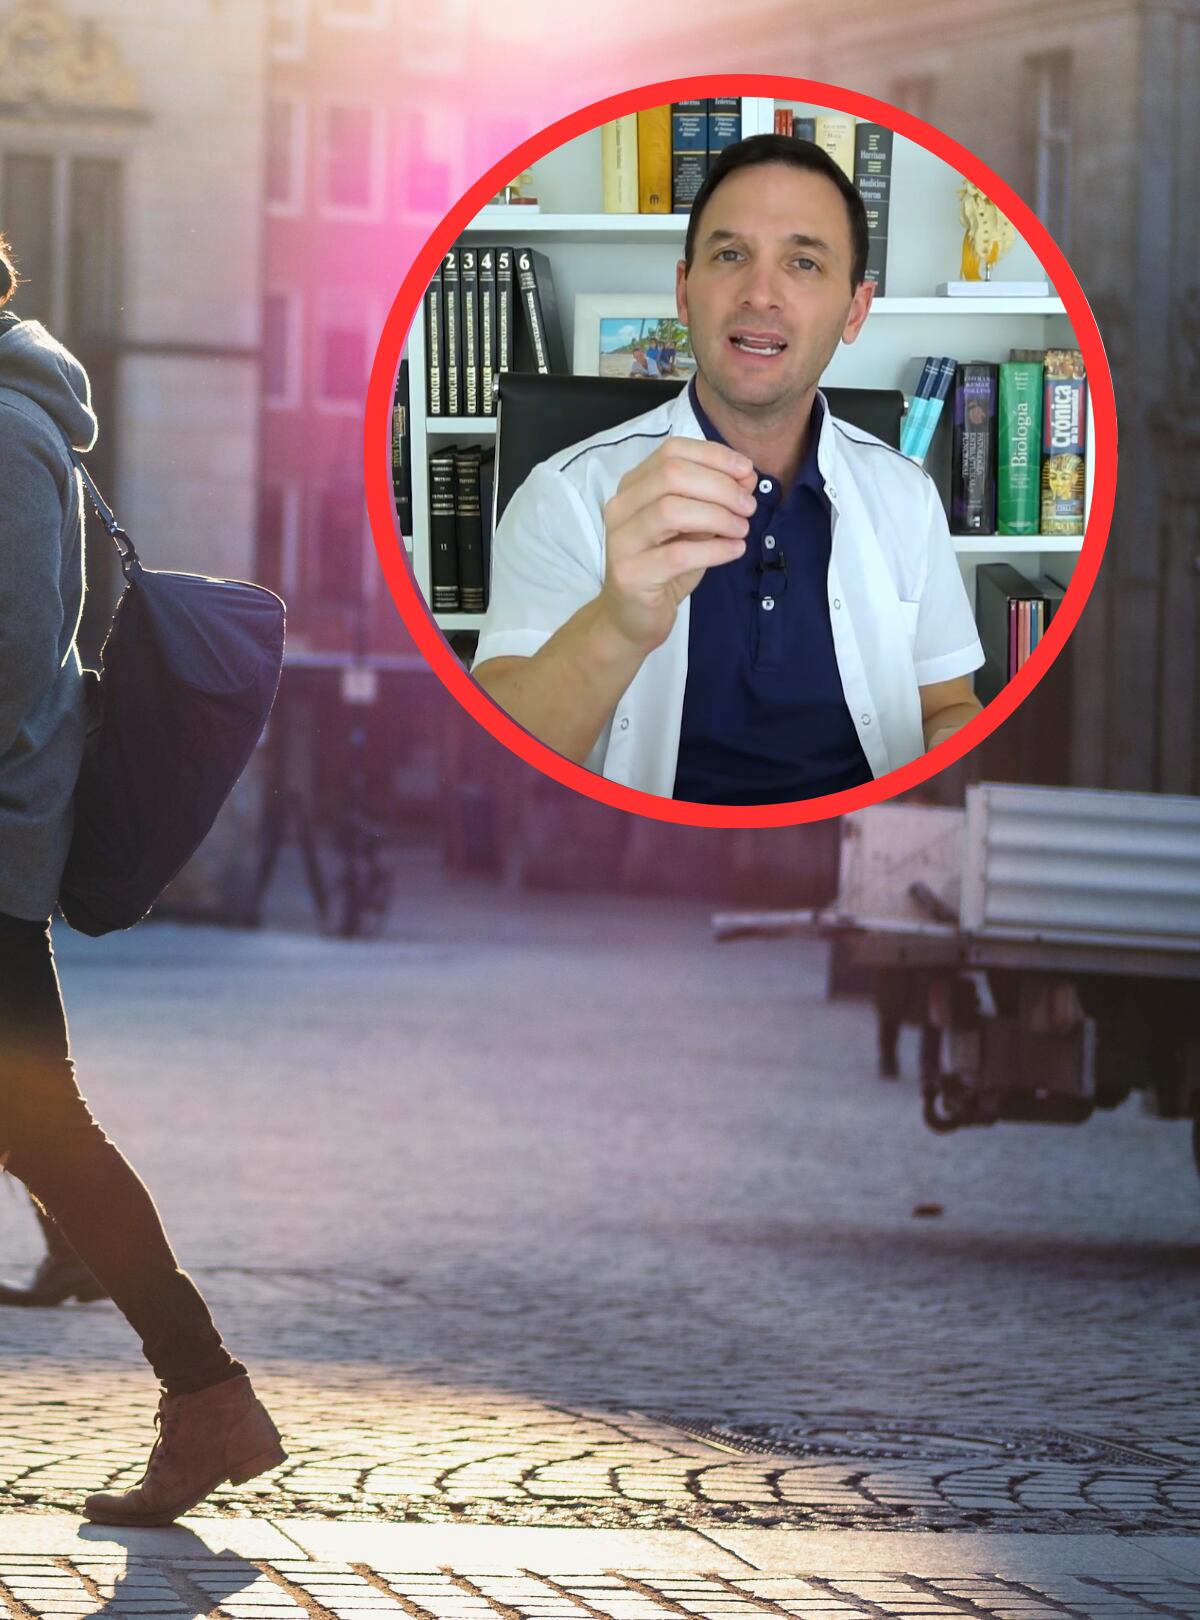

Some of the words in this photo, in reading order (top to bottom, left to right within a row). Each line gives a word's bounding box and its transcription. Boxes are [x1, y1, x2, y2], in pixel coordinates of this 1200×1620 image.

[860, 150, 886, 160] Harrison
[446, 252, 456, 269] 2
[464, 252, 474, 269] 3
[482, 252, 492, 270] 4
[499, 252, 509, 269] 5
[520, 254, 530, 270] 6
[1052, 384, 1072, 448] Crónica
[1012, 402, 1032, 466] Biología
